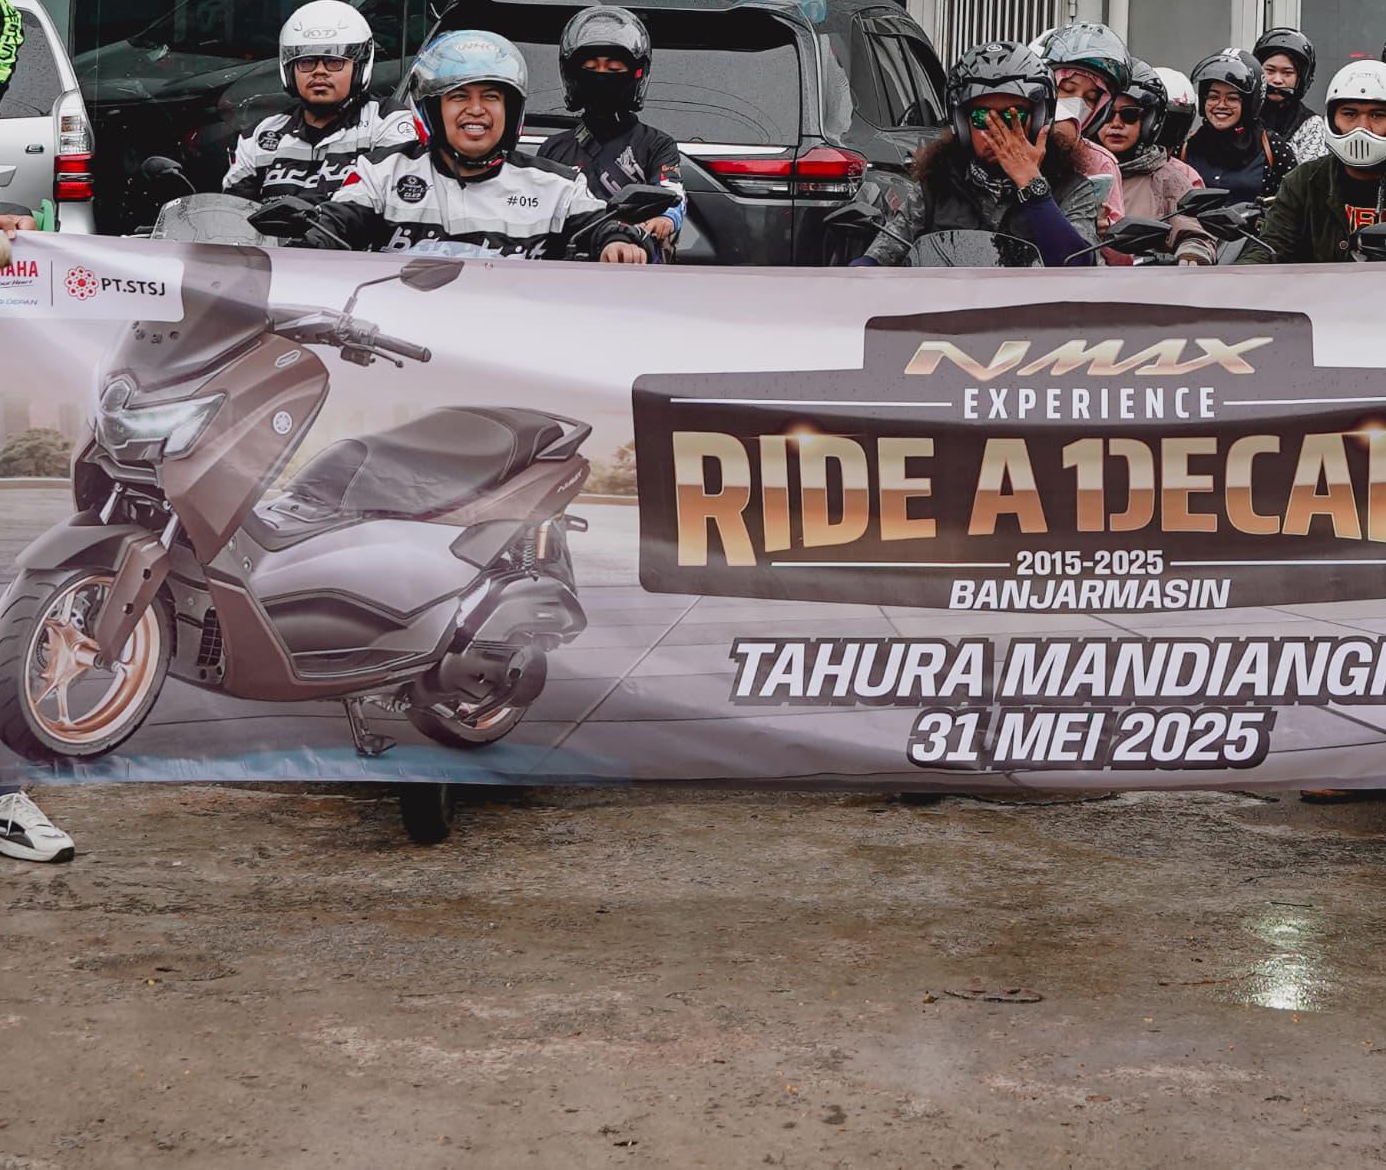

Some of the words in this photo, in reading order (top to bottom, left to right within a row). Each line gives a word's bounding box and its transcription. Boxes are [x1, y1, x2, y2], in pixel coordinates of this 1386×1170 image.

[506, 195, 539, 208] #015
[101, 278, 166, 297] PT.STSJ
[902, 336, 1274, 382] NMAX
[962, 386, 1219, 420] EXPERIENCE
[670, 431, 937, 568] RIDE
[967, 437, 1050, 536] A
[1016, 550, 1164, 575] 2015-2025
[948, 578, 1231, 611] BANJARMASIN
[731, 640, 997, 700] TAHURA
[911, 712, 981, 764] 31
[993, 712, 1105, 762] MEI
[1113, 712, 1265, 764] 2025
